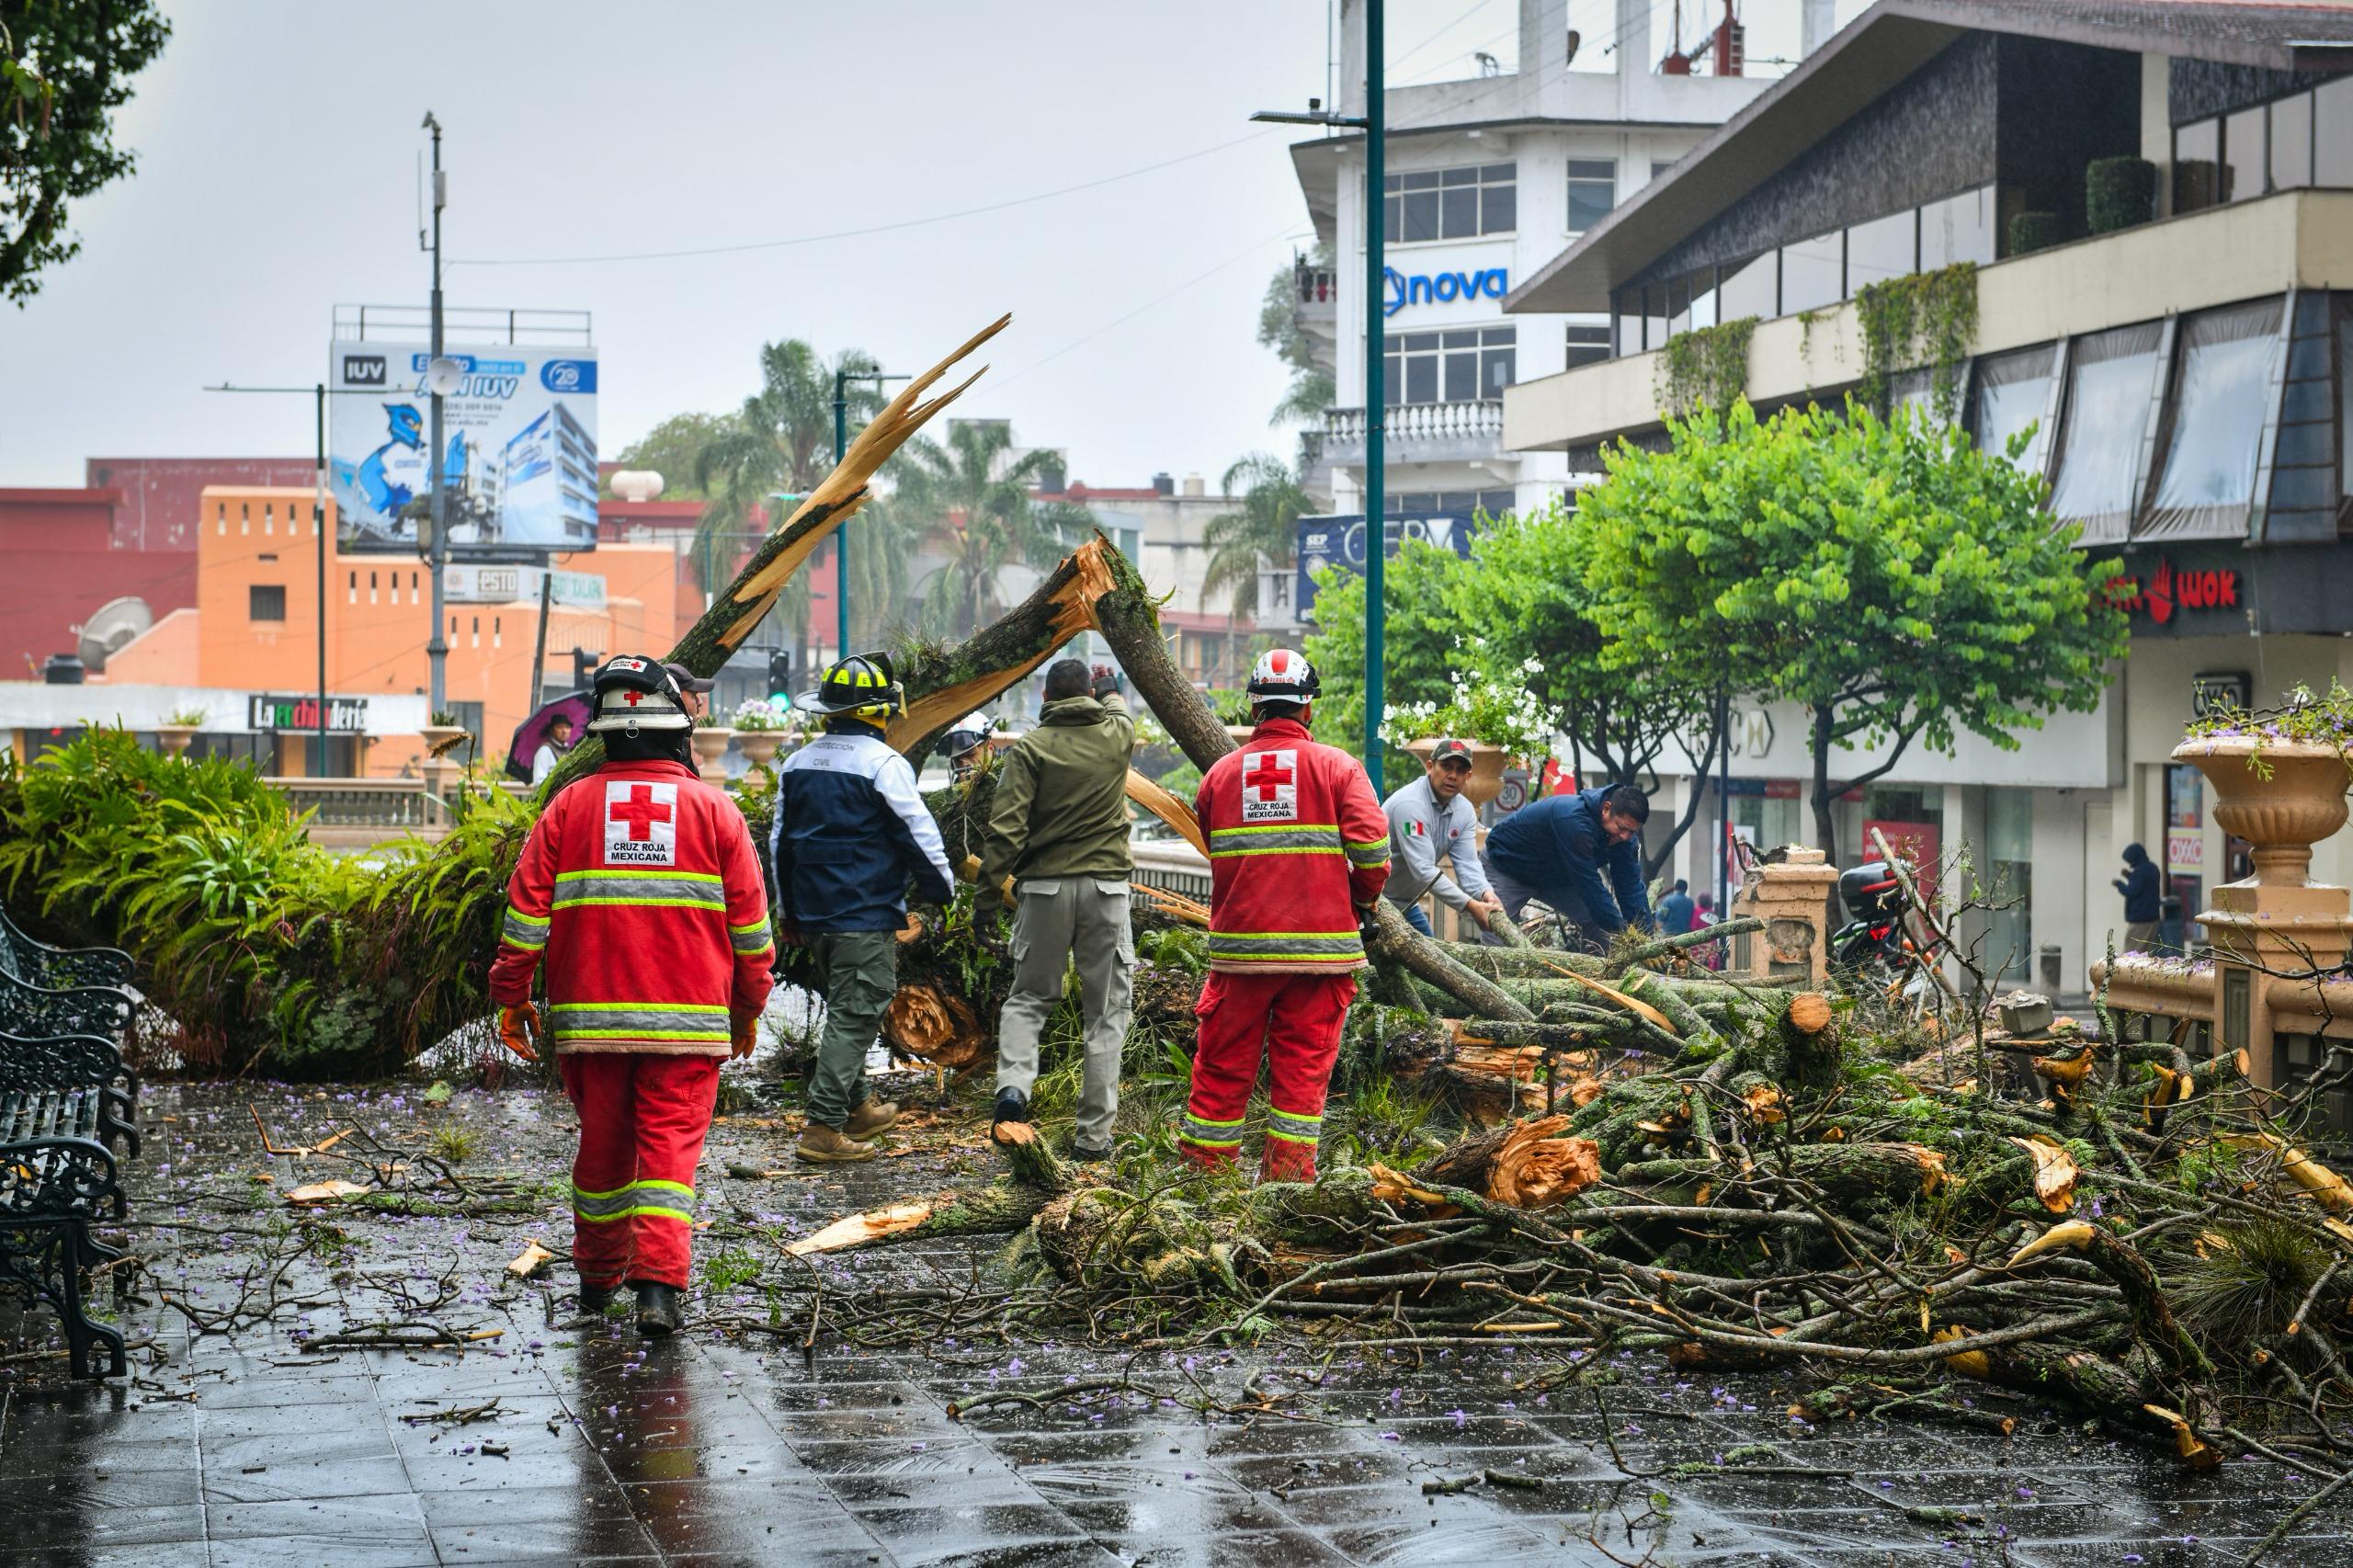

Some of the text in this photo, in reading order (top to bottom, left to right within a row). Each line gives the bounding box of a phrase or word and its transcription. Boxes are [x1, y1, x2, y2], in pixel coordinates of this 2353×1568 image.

[1409, 268, 1508, 305] nova
[347, 362, 384, 380] IUV
[474, 377, 518, 400] IUV
[1306, 534, 1328, 546] SEP
[2177, 569, 2236, 608] WOK
[813, 758, 831, 767] CIVIL
[1502, 786, 1518, 801] 30
[1247, 810, 1291, 819] MEXICANA
[613, 842, 666, 852] CRUZ ROJA
[2169, 837, 2202, 863] OXXO
[611, 852, 667, 862] MEXICANA
